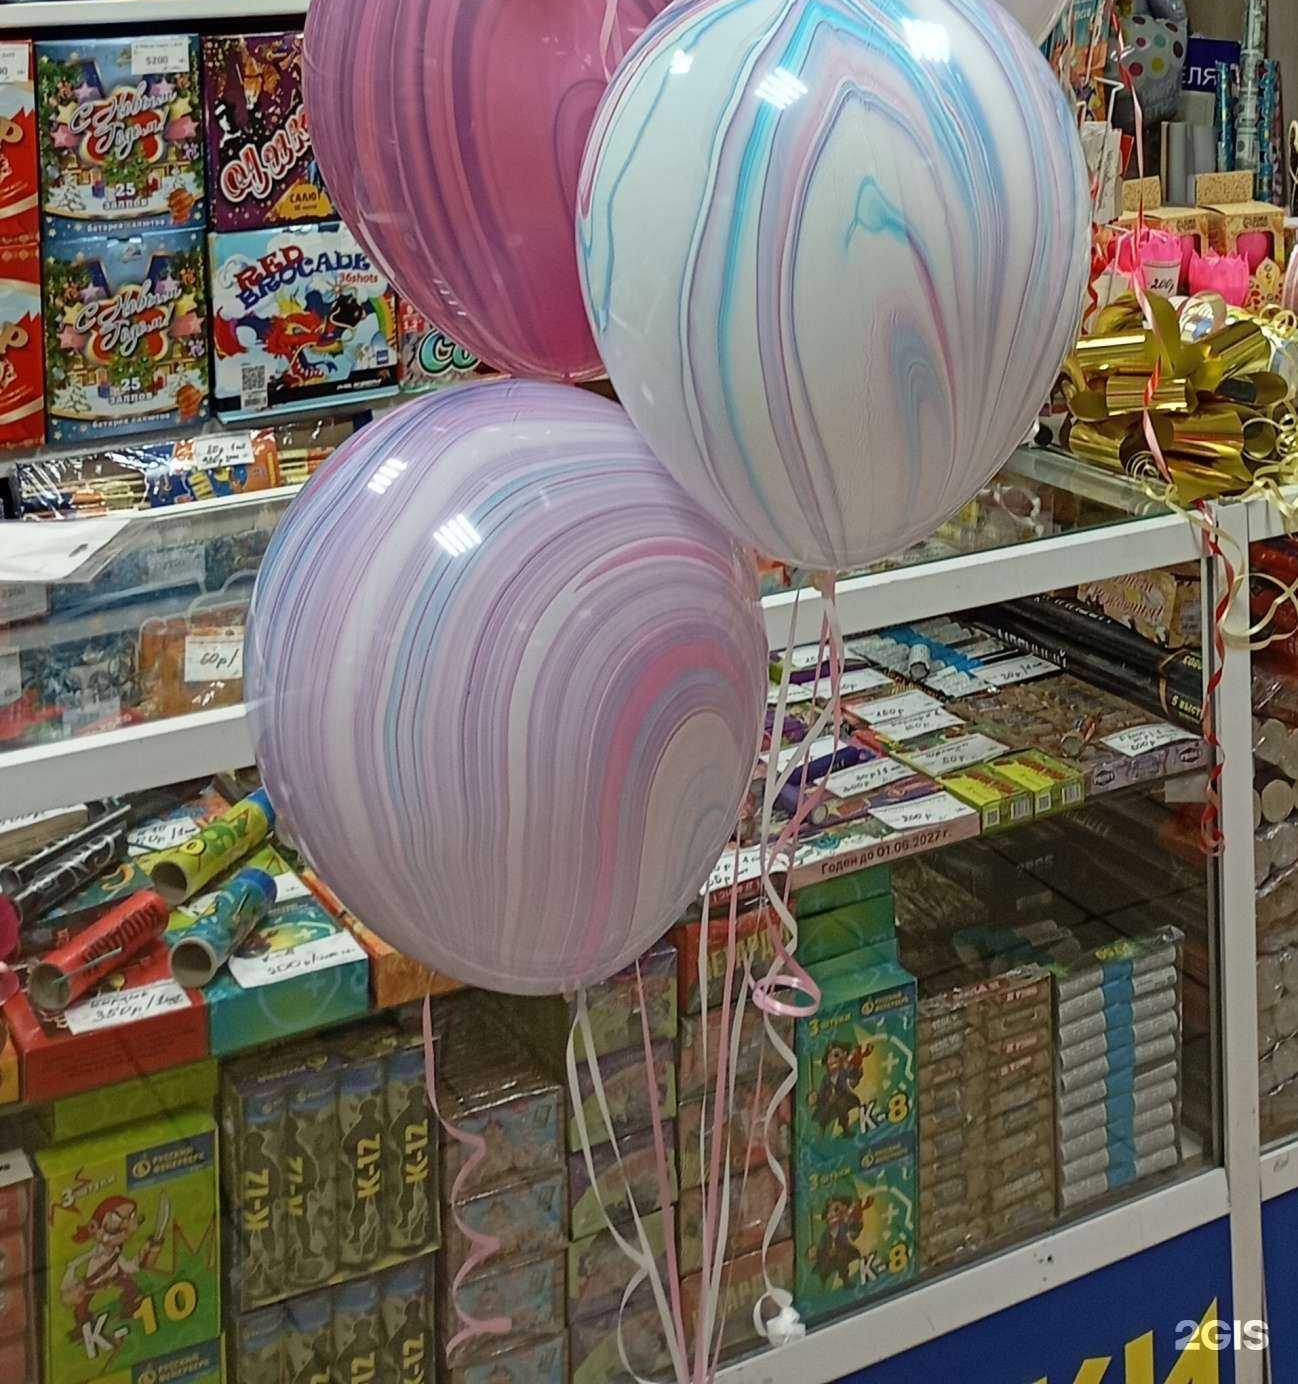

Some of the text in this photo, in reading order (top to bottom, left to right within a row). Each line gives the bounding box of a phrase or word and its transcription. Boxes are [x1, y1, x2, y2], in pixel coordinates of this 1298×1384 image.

[115, 183, 136, 196] 25
[235, 245, 304, 291] RED
[237, 250, 370, 310] BROCADE
[120, 377, 141, 390] 25
[821, 857, 857, 875] Годен
[860, 851, 875, 866] до
[61, 1189, 75, 1208] 3
